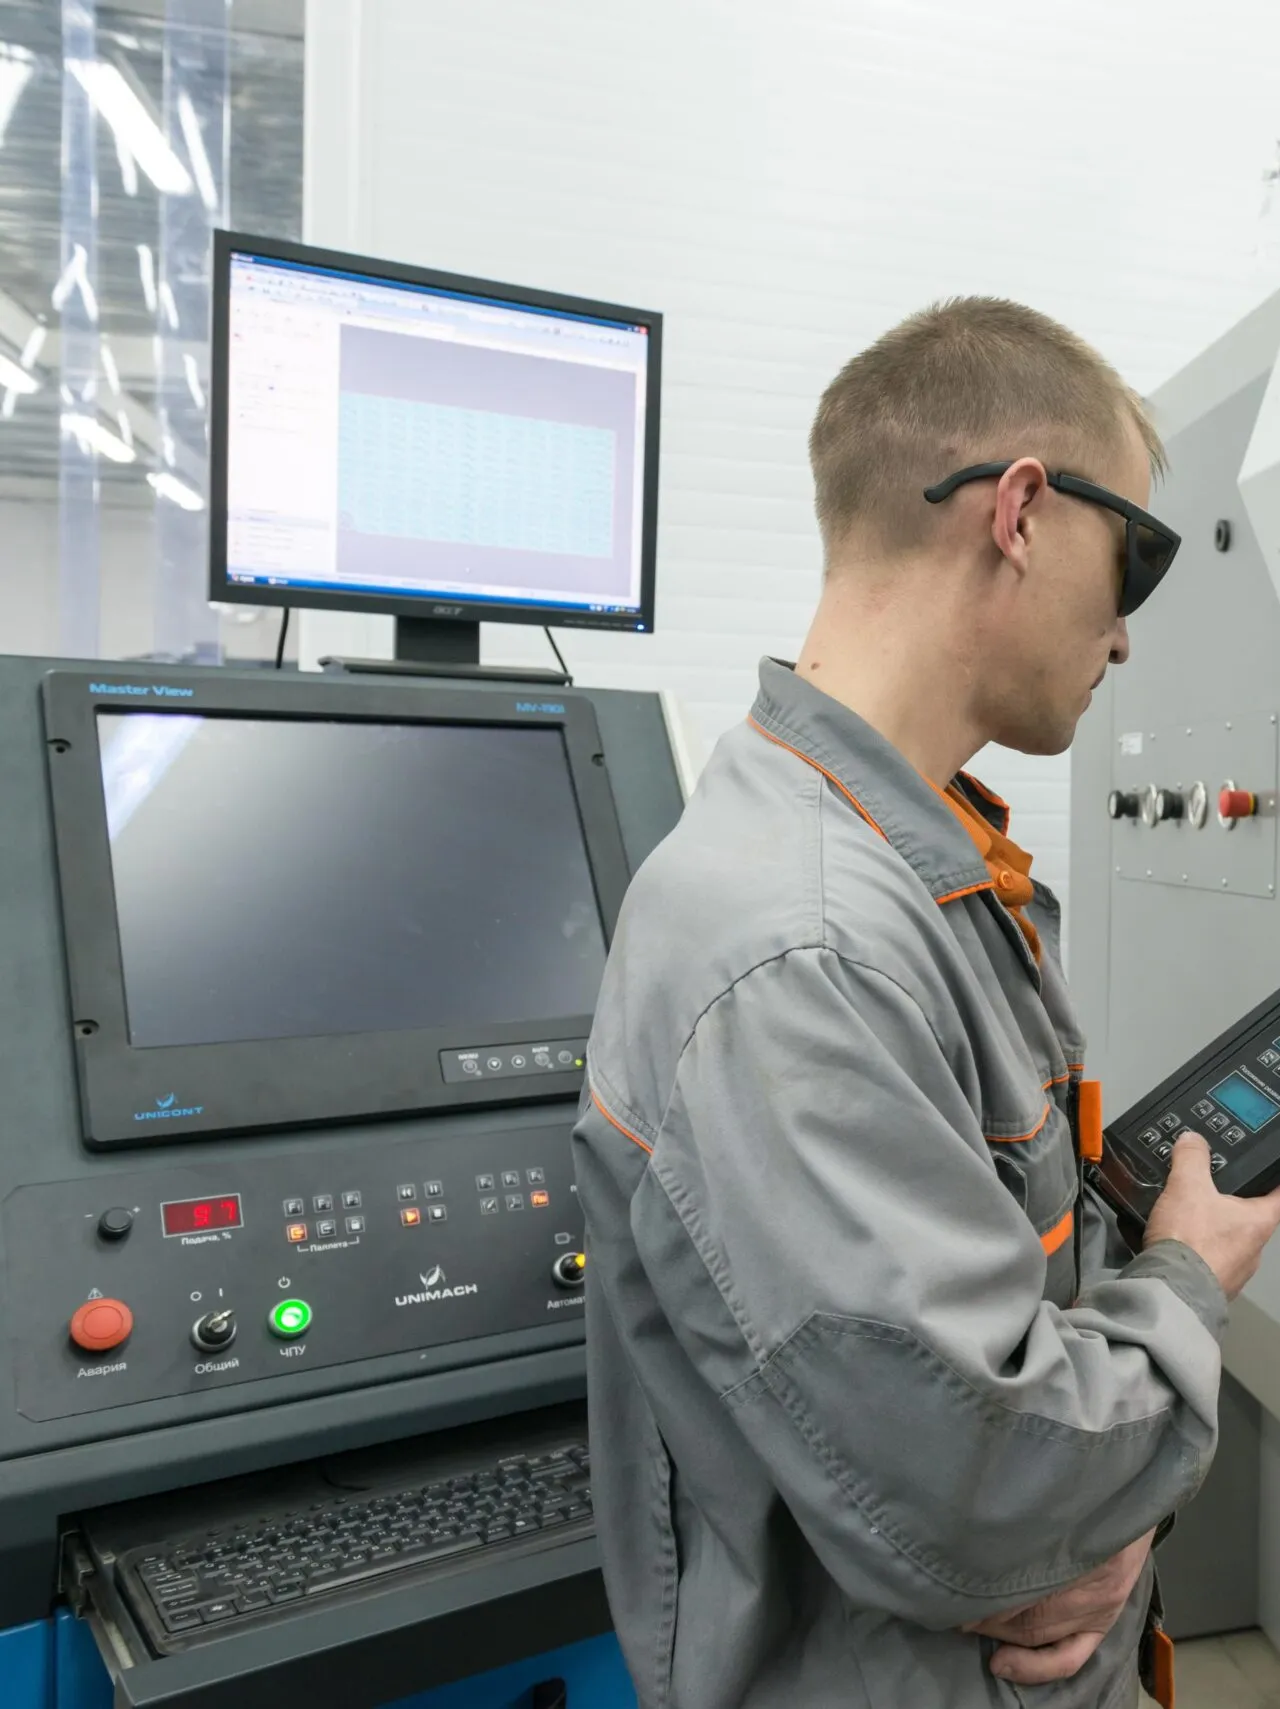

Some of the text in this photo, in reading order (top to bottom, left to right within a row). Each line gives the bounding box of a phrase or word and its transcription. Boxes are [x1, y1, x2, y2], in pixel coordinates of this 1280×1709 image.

[89, 683, 193, 697] Master View
[134, 1106, 203, 1121] UNICONT
[193, 1200, 237, 1228] 97
[395, 1283, 478, 1306] UNIMACH
[280, 1345, 306, 1358] ЧПУ
[77, 1362, 127, 1378] Авария
[195, 1358, 240, 1374] Общий
